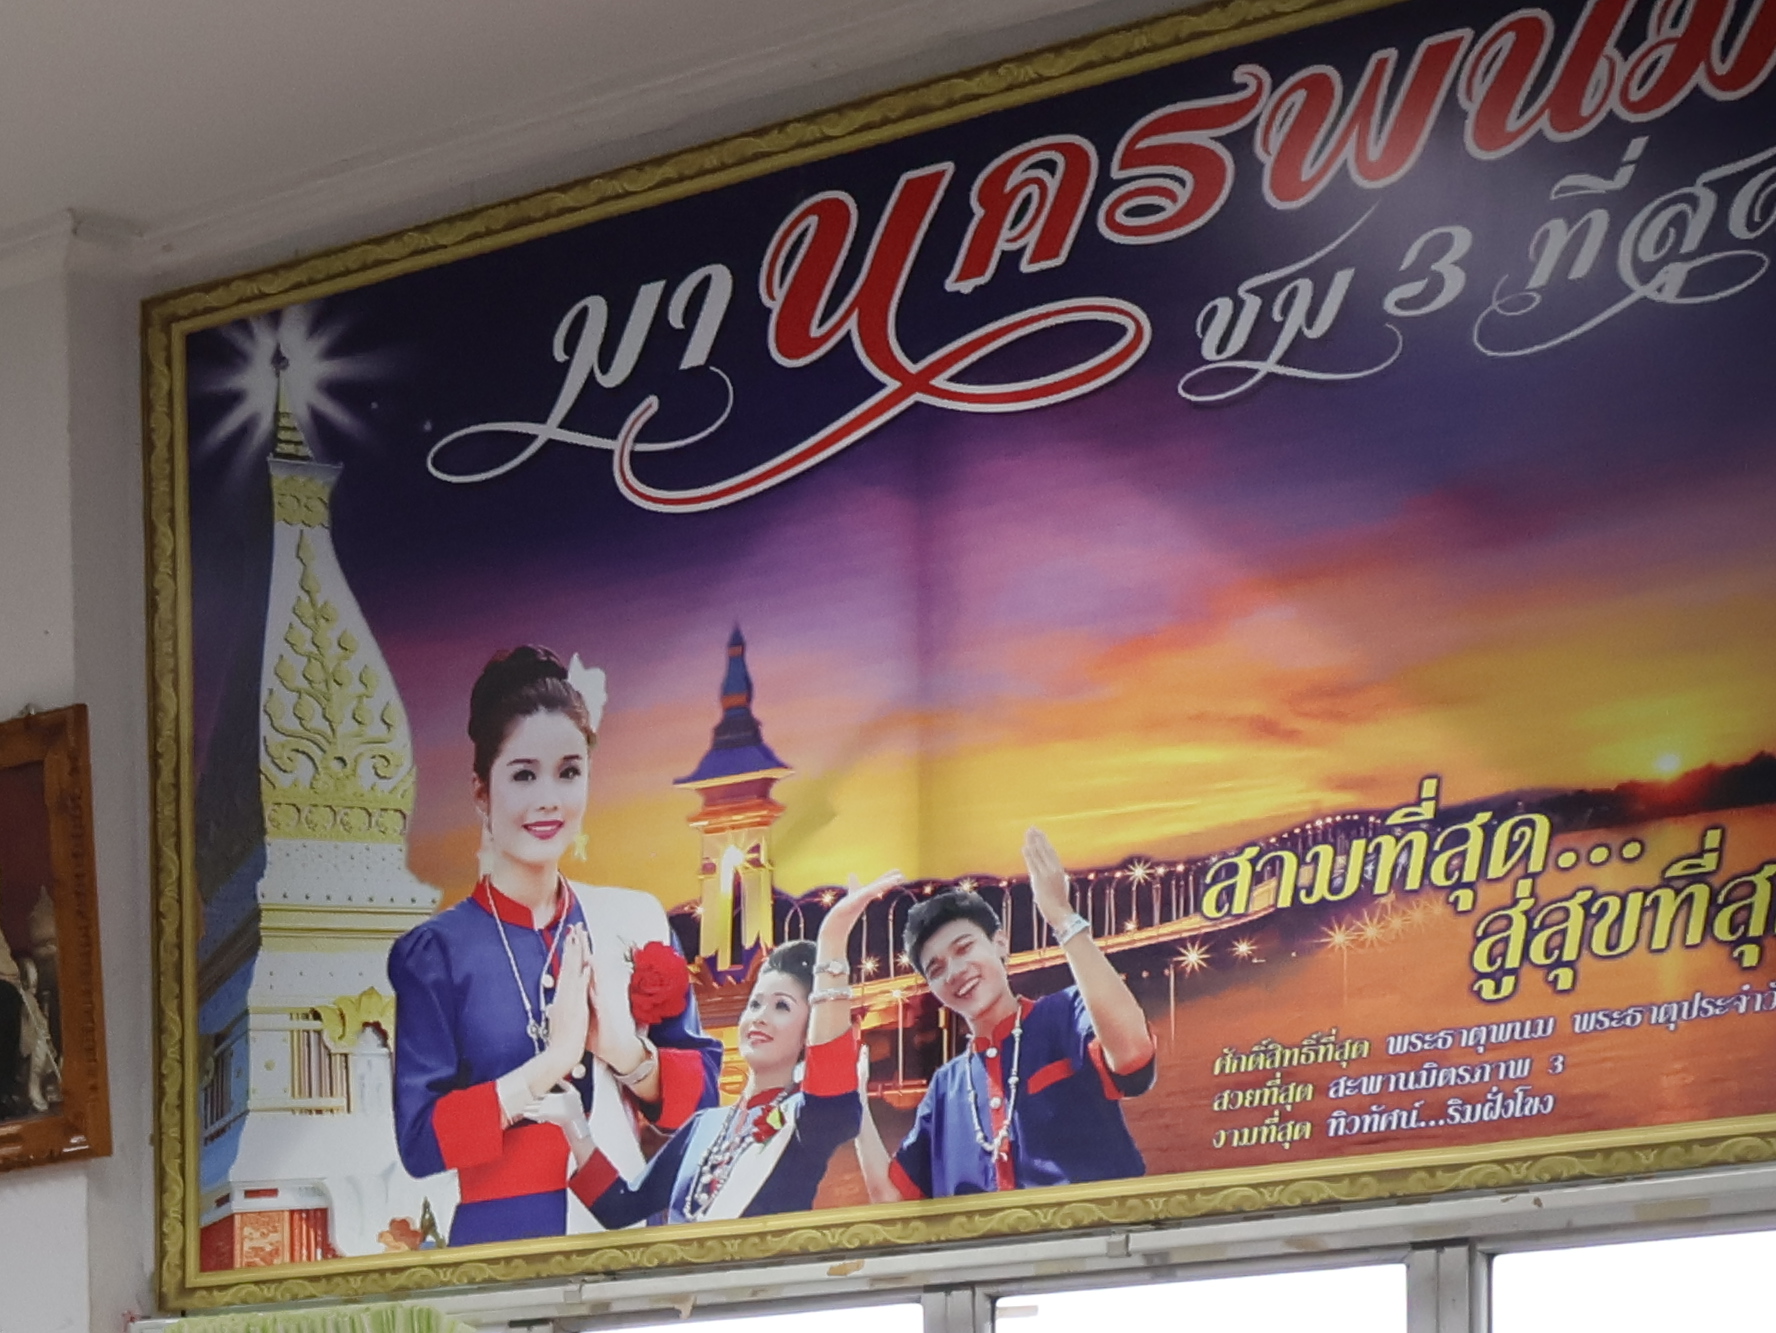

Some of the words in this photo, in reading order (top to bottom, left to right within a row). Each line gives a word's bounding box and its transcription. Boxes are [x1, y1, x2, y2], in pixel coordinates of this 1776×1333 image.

[1382, 224, 1474, 317] 3
[1471, 828, 1776, 1001] สู่สุขที่สุ
[1213, 1028, 1370, 1075] ศักดิ์สิทธิ์ที่สุด
[1387, 1015, 1555, 1056] พระธาตุพนม
[1213, 1073, 1314, 1112] สวยที่สุด
[1329, 1056, 1532, 1098] สะพานมิตรภาพ
[1548, 1055, 1565, 1074] 3
[1213, 1110, 1312, 1149] งามที่สุด
